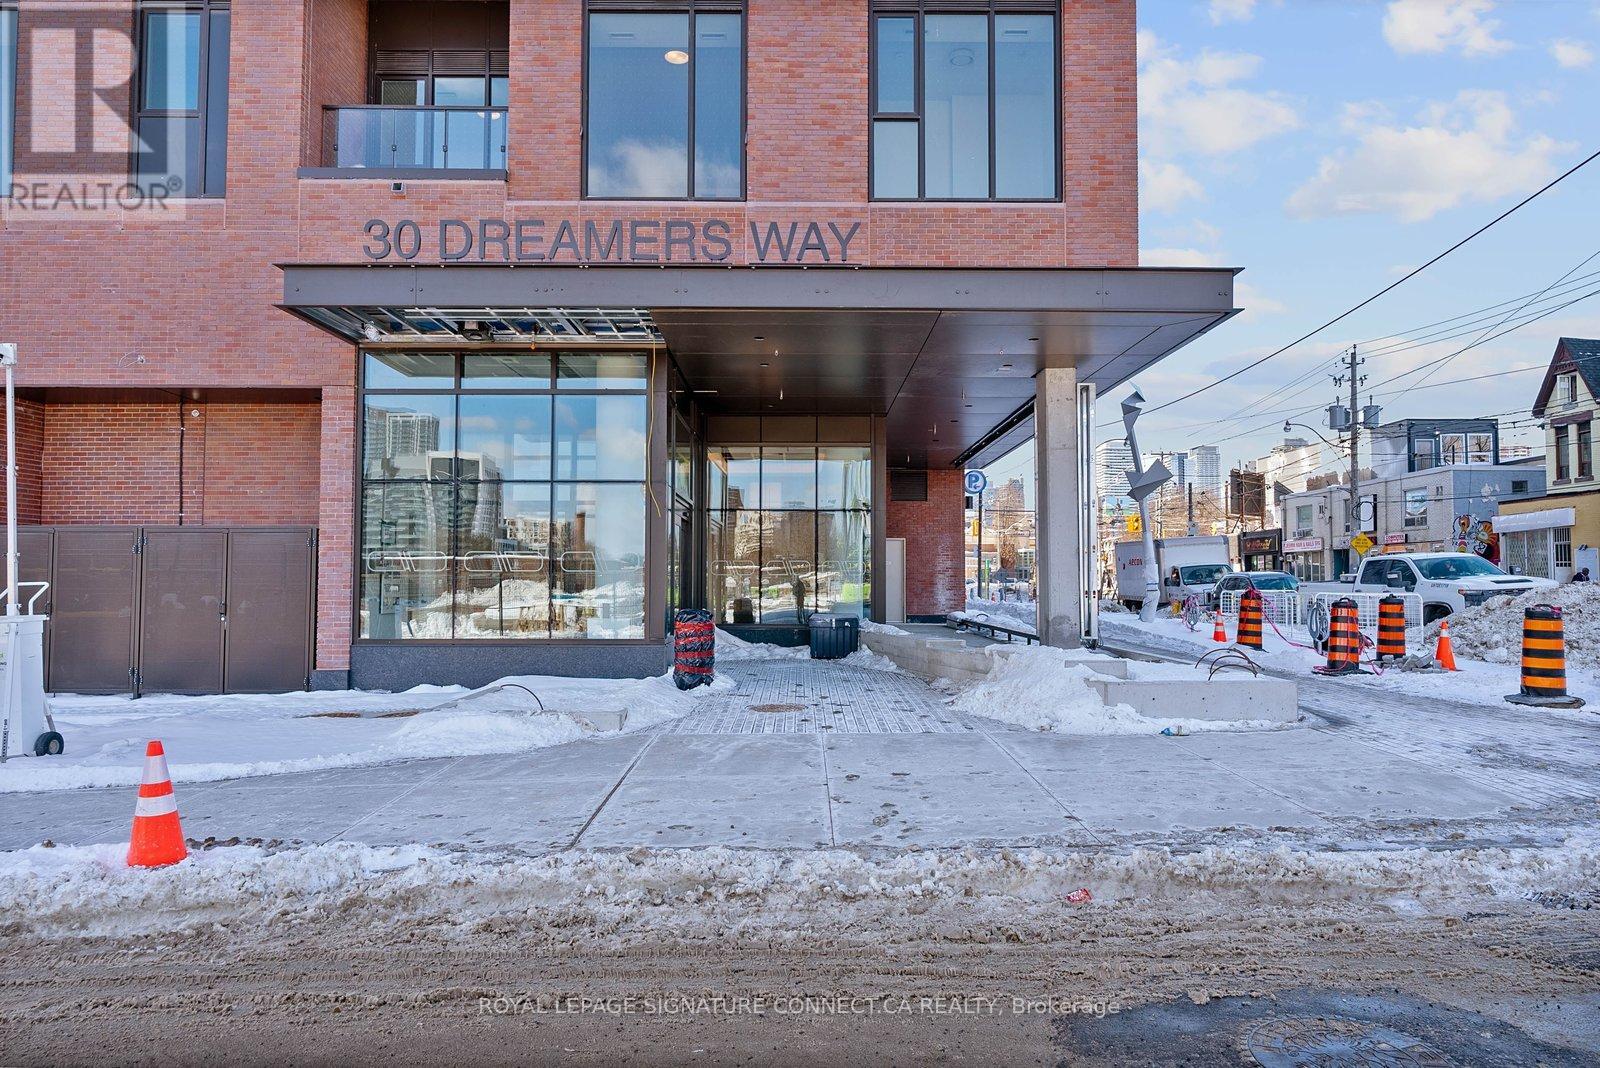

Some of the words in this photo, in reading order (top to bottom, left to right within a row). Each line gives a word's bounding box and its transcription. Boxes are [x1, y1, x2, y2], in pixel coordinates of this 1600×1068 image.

[363, 219, 422, 260] 30
[439, 219, 732, 260] DREAMERS
[750, 222, 862, 261] WAY
